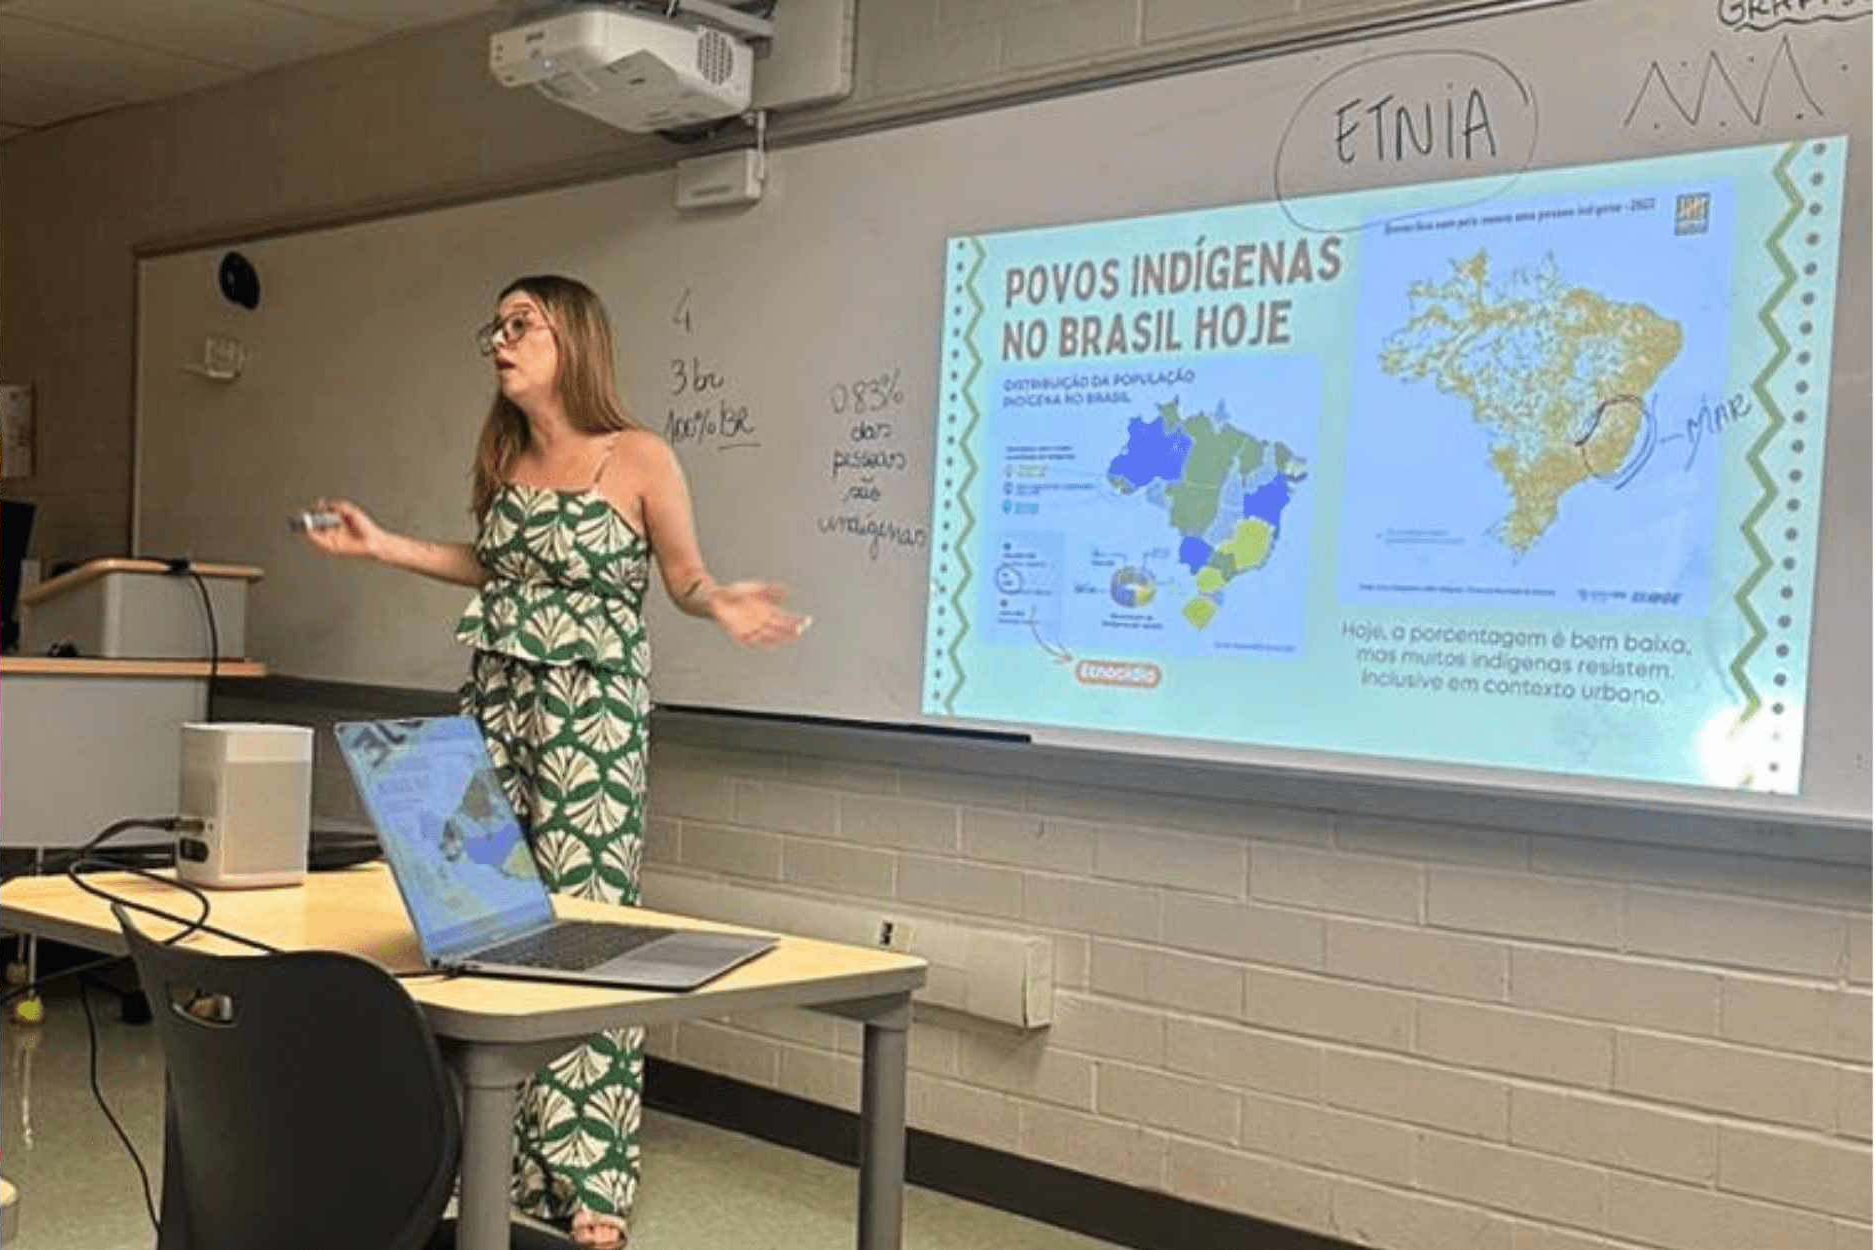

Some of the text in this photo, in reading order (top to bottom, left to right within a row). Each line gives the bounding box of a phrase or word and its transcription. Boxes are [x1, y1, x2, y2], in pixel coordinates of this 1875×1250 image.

[1335, 88, 1496, 163] ETNIA
[1006, 234, 1343, 309] POVOS INDÍGENAS
[1002, 299, 1293, 361] NO BRASIL HOJE
[672, 358, 687, 397] 3
[1341, 620, 1693, 656] Hoje, a porcentagem é bem baixa,
[1356, 648, 1397, 664] mas
[1401, 648, 1466, 667] muitos
[1472, 650, 1572, 674] indígenas
[1360, 668, 1444, 691] Inclusive
[1447, 675, 1479, 692] em
[1483, 676, 1576, 699] contexto
